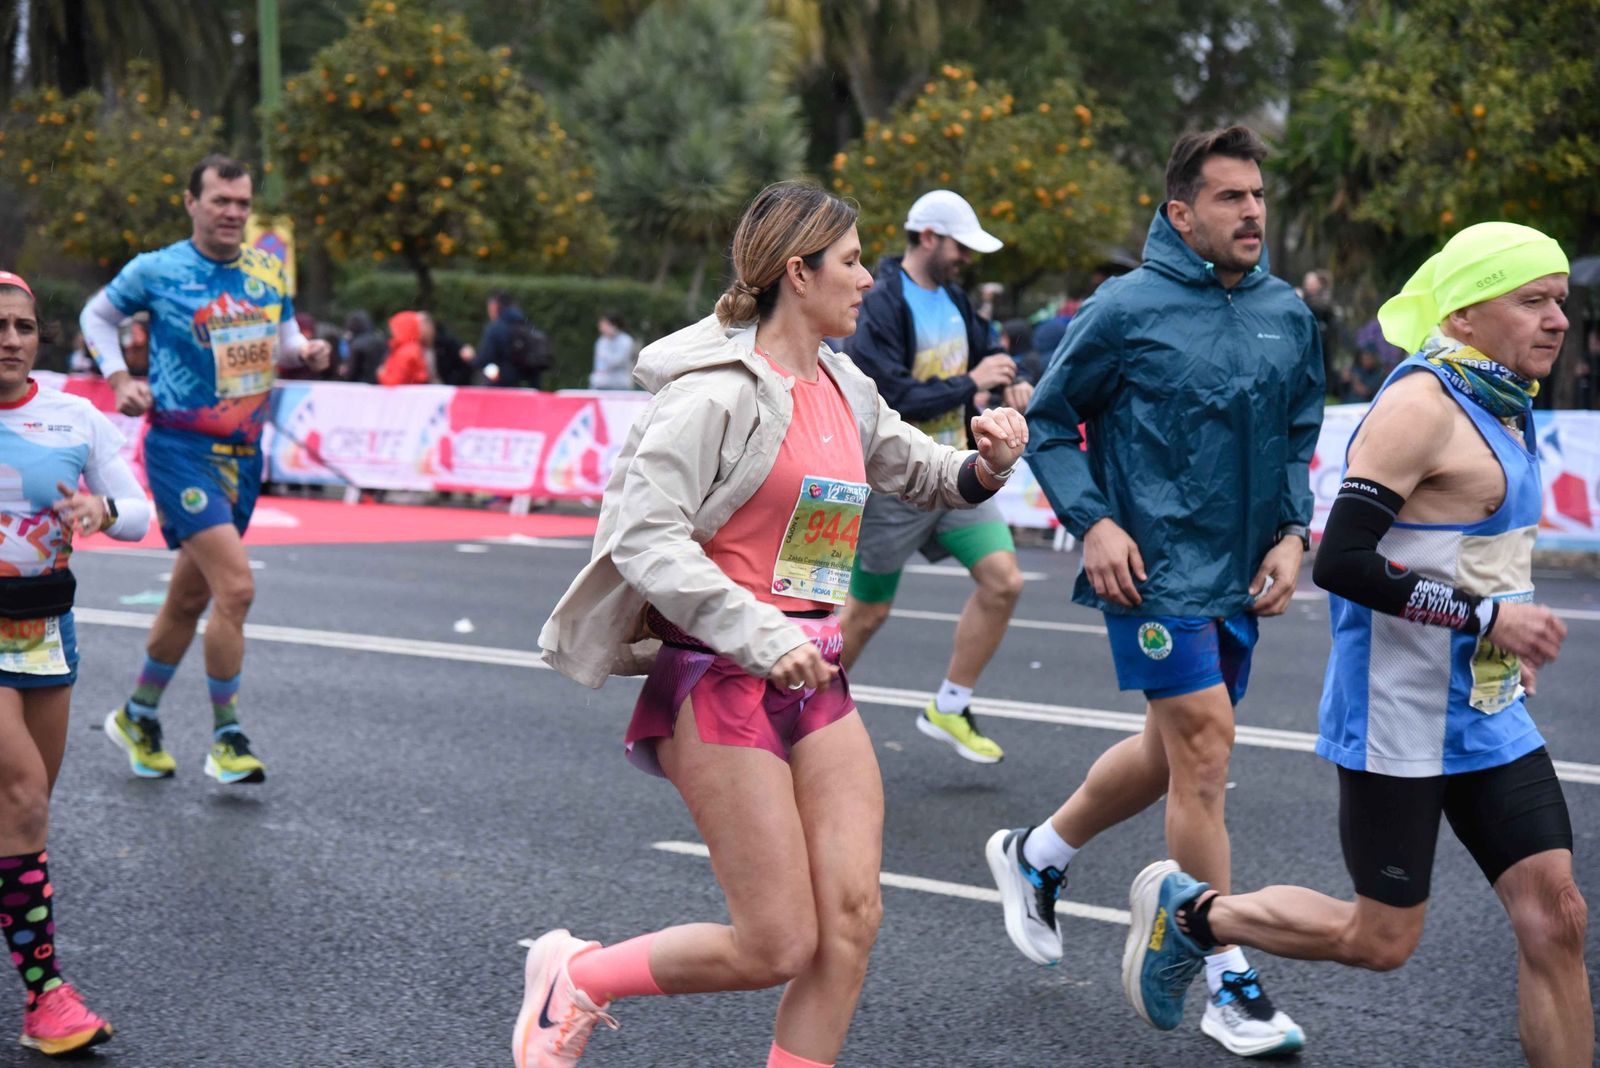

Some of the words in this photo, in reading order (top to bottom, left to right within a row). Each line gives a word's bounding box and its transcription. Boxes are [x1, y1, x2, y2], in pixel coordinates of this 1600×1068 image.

[1476, 269, 1504, 288] GORE
[227, 342, 269, 367] 5966
[1341, 481, 1378, 495] ORMA
[804, 509, 861, 550] 944
